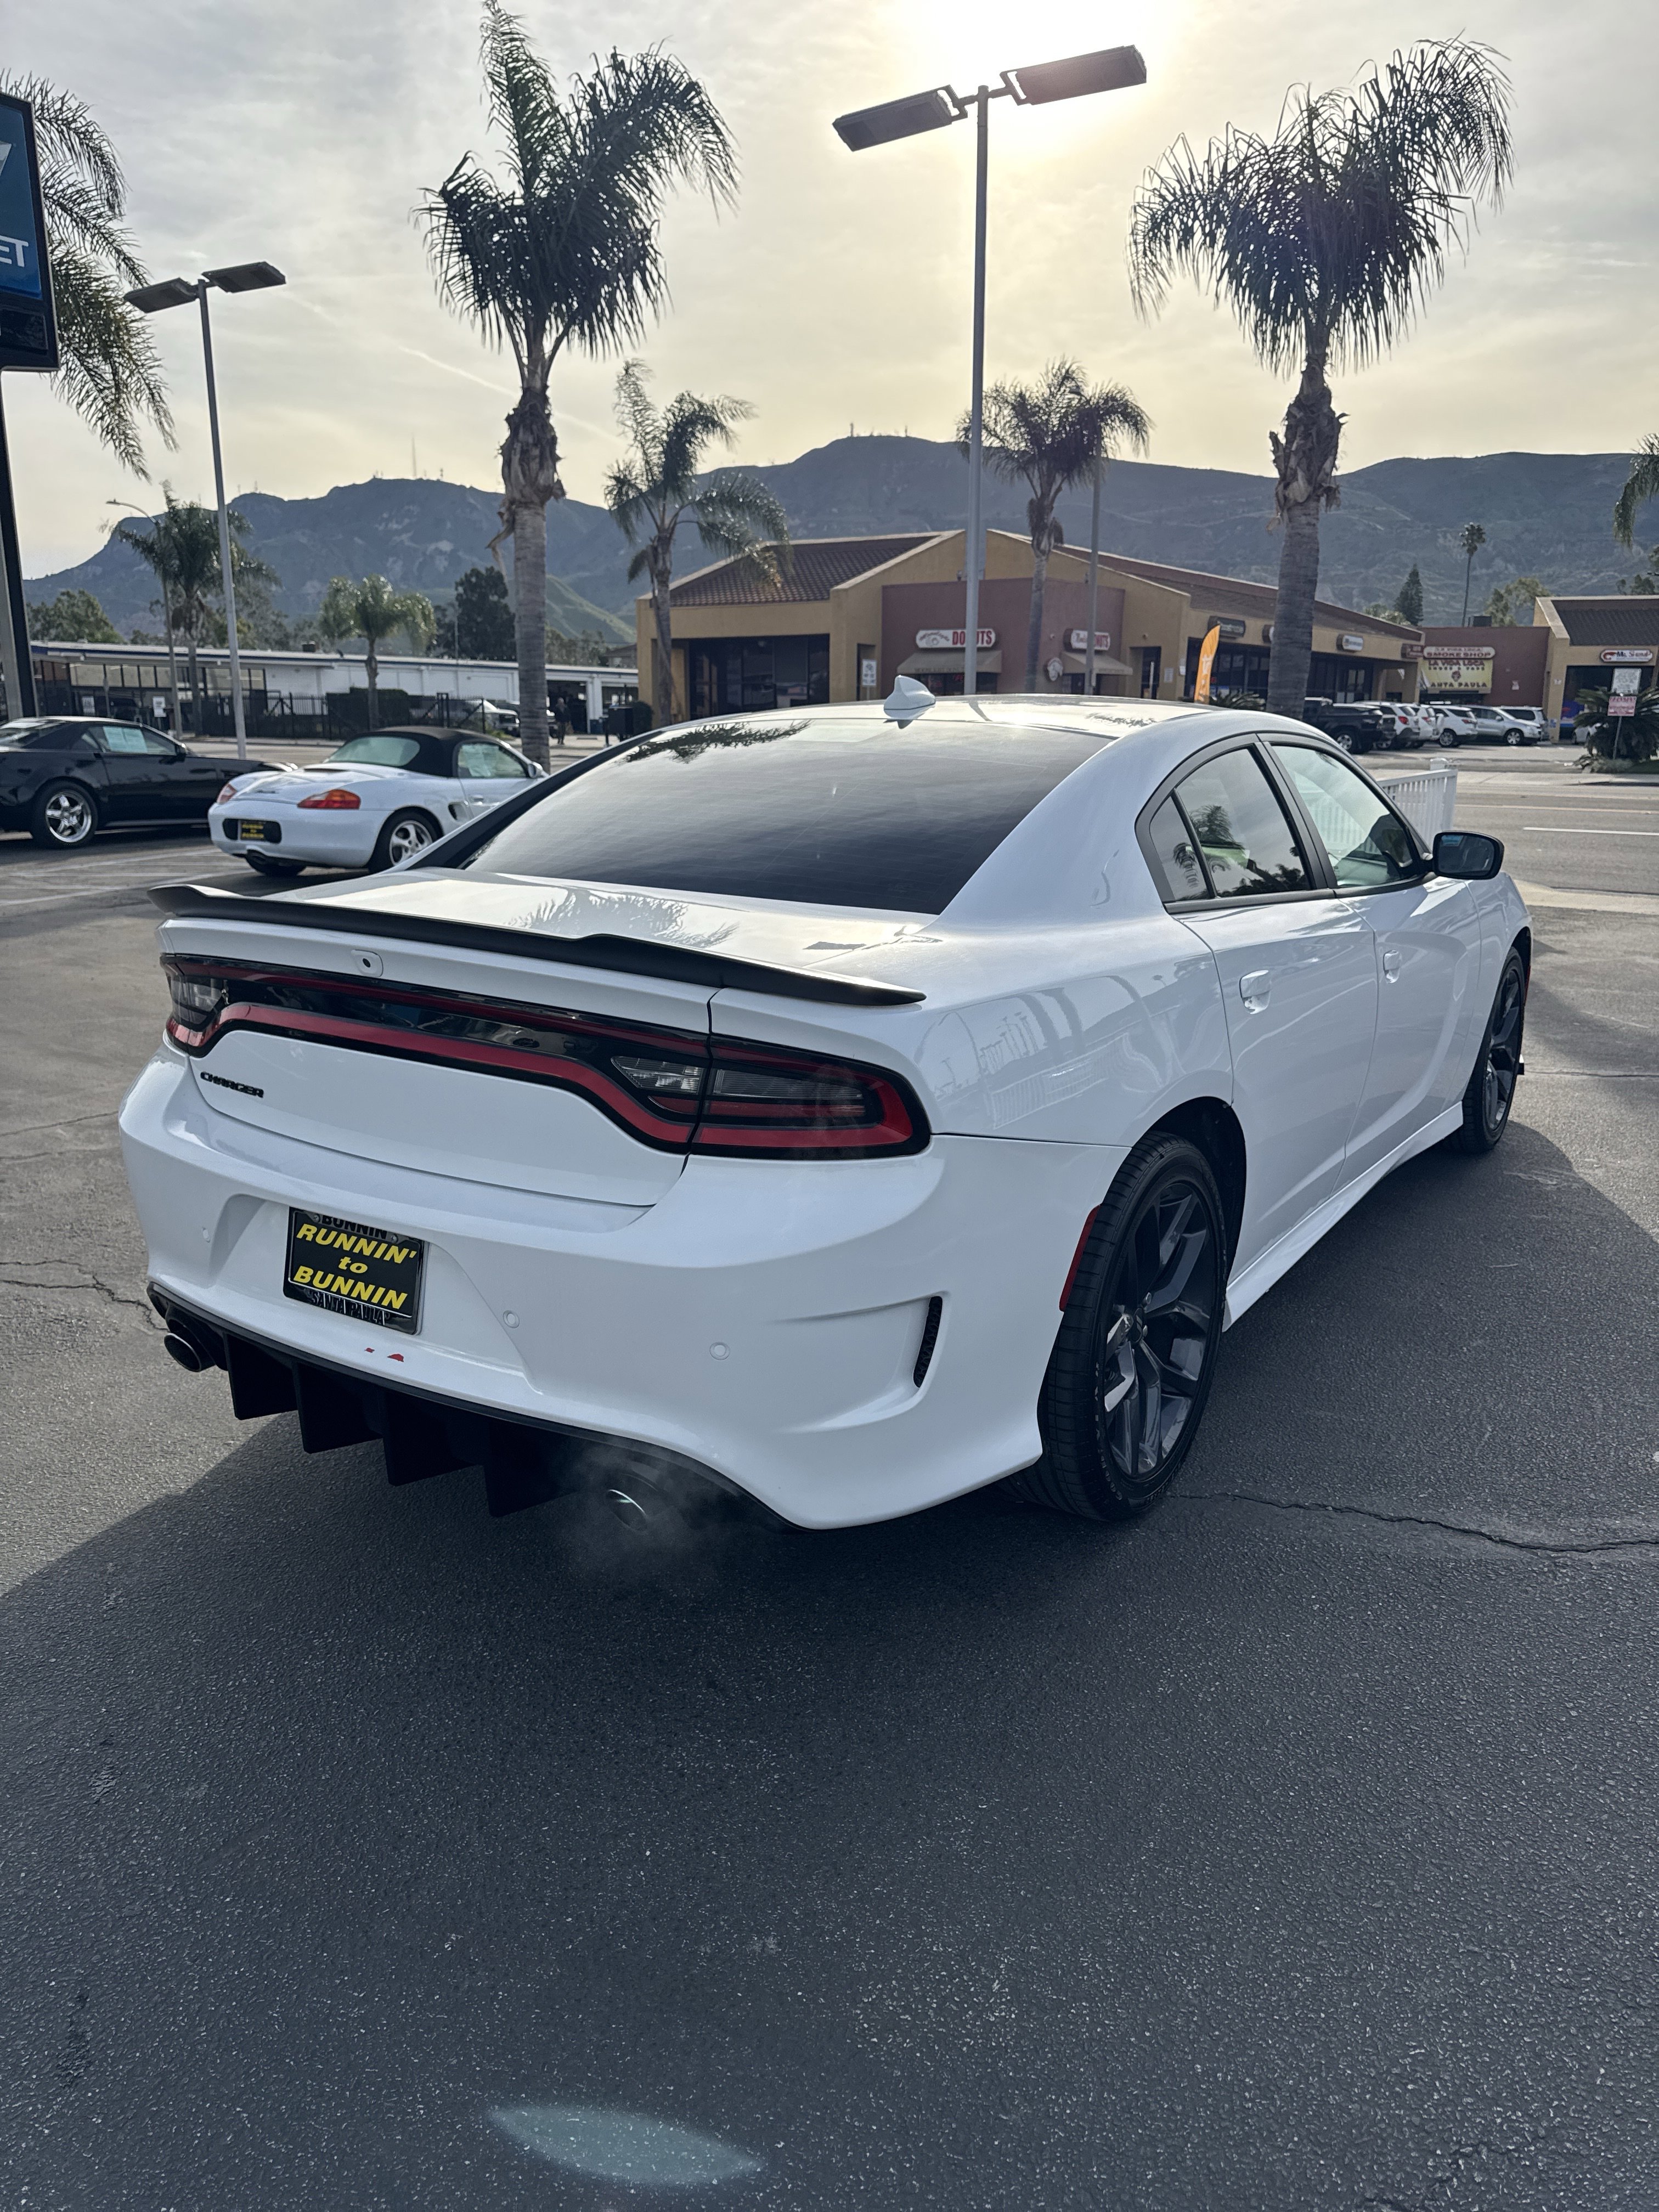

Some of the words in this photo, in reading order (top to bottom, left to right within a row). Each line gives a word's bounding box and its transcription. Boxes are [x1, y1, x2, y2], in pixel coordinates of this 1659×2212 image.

[952, 630, 992, 645] DOTS
[200, 1071, 263, 1098] CHARGER
[296, 1223, 417, 1264] RUNNIN'
[338, 1256, 368, 1273] to
[293, 1265, 408, 1310] BUNNIN
[312, 1291, 346, 1314] SANTA
[351, 1301, 385, 1325] PAULA
